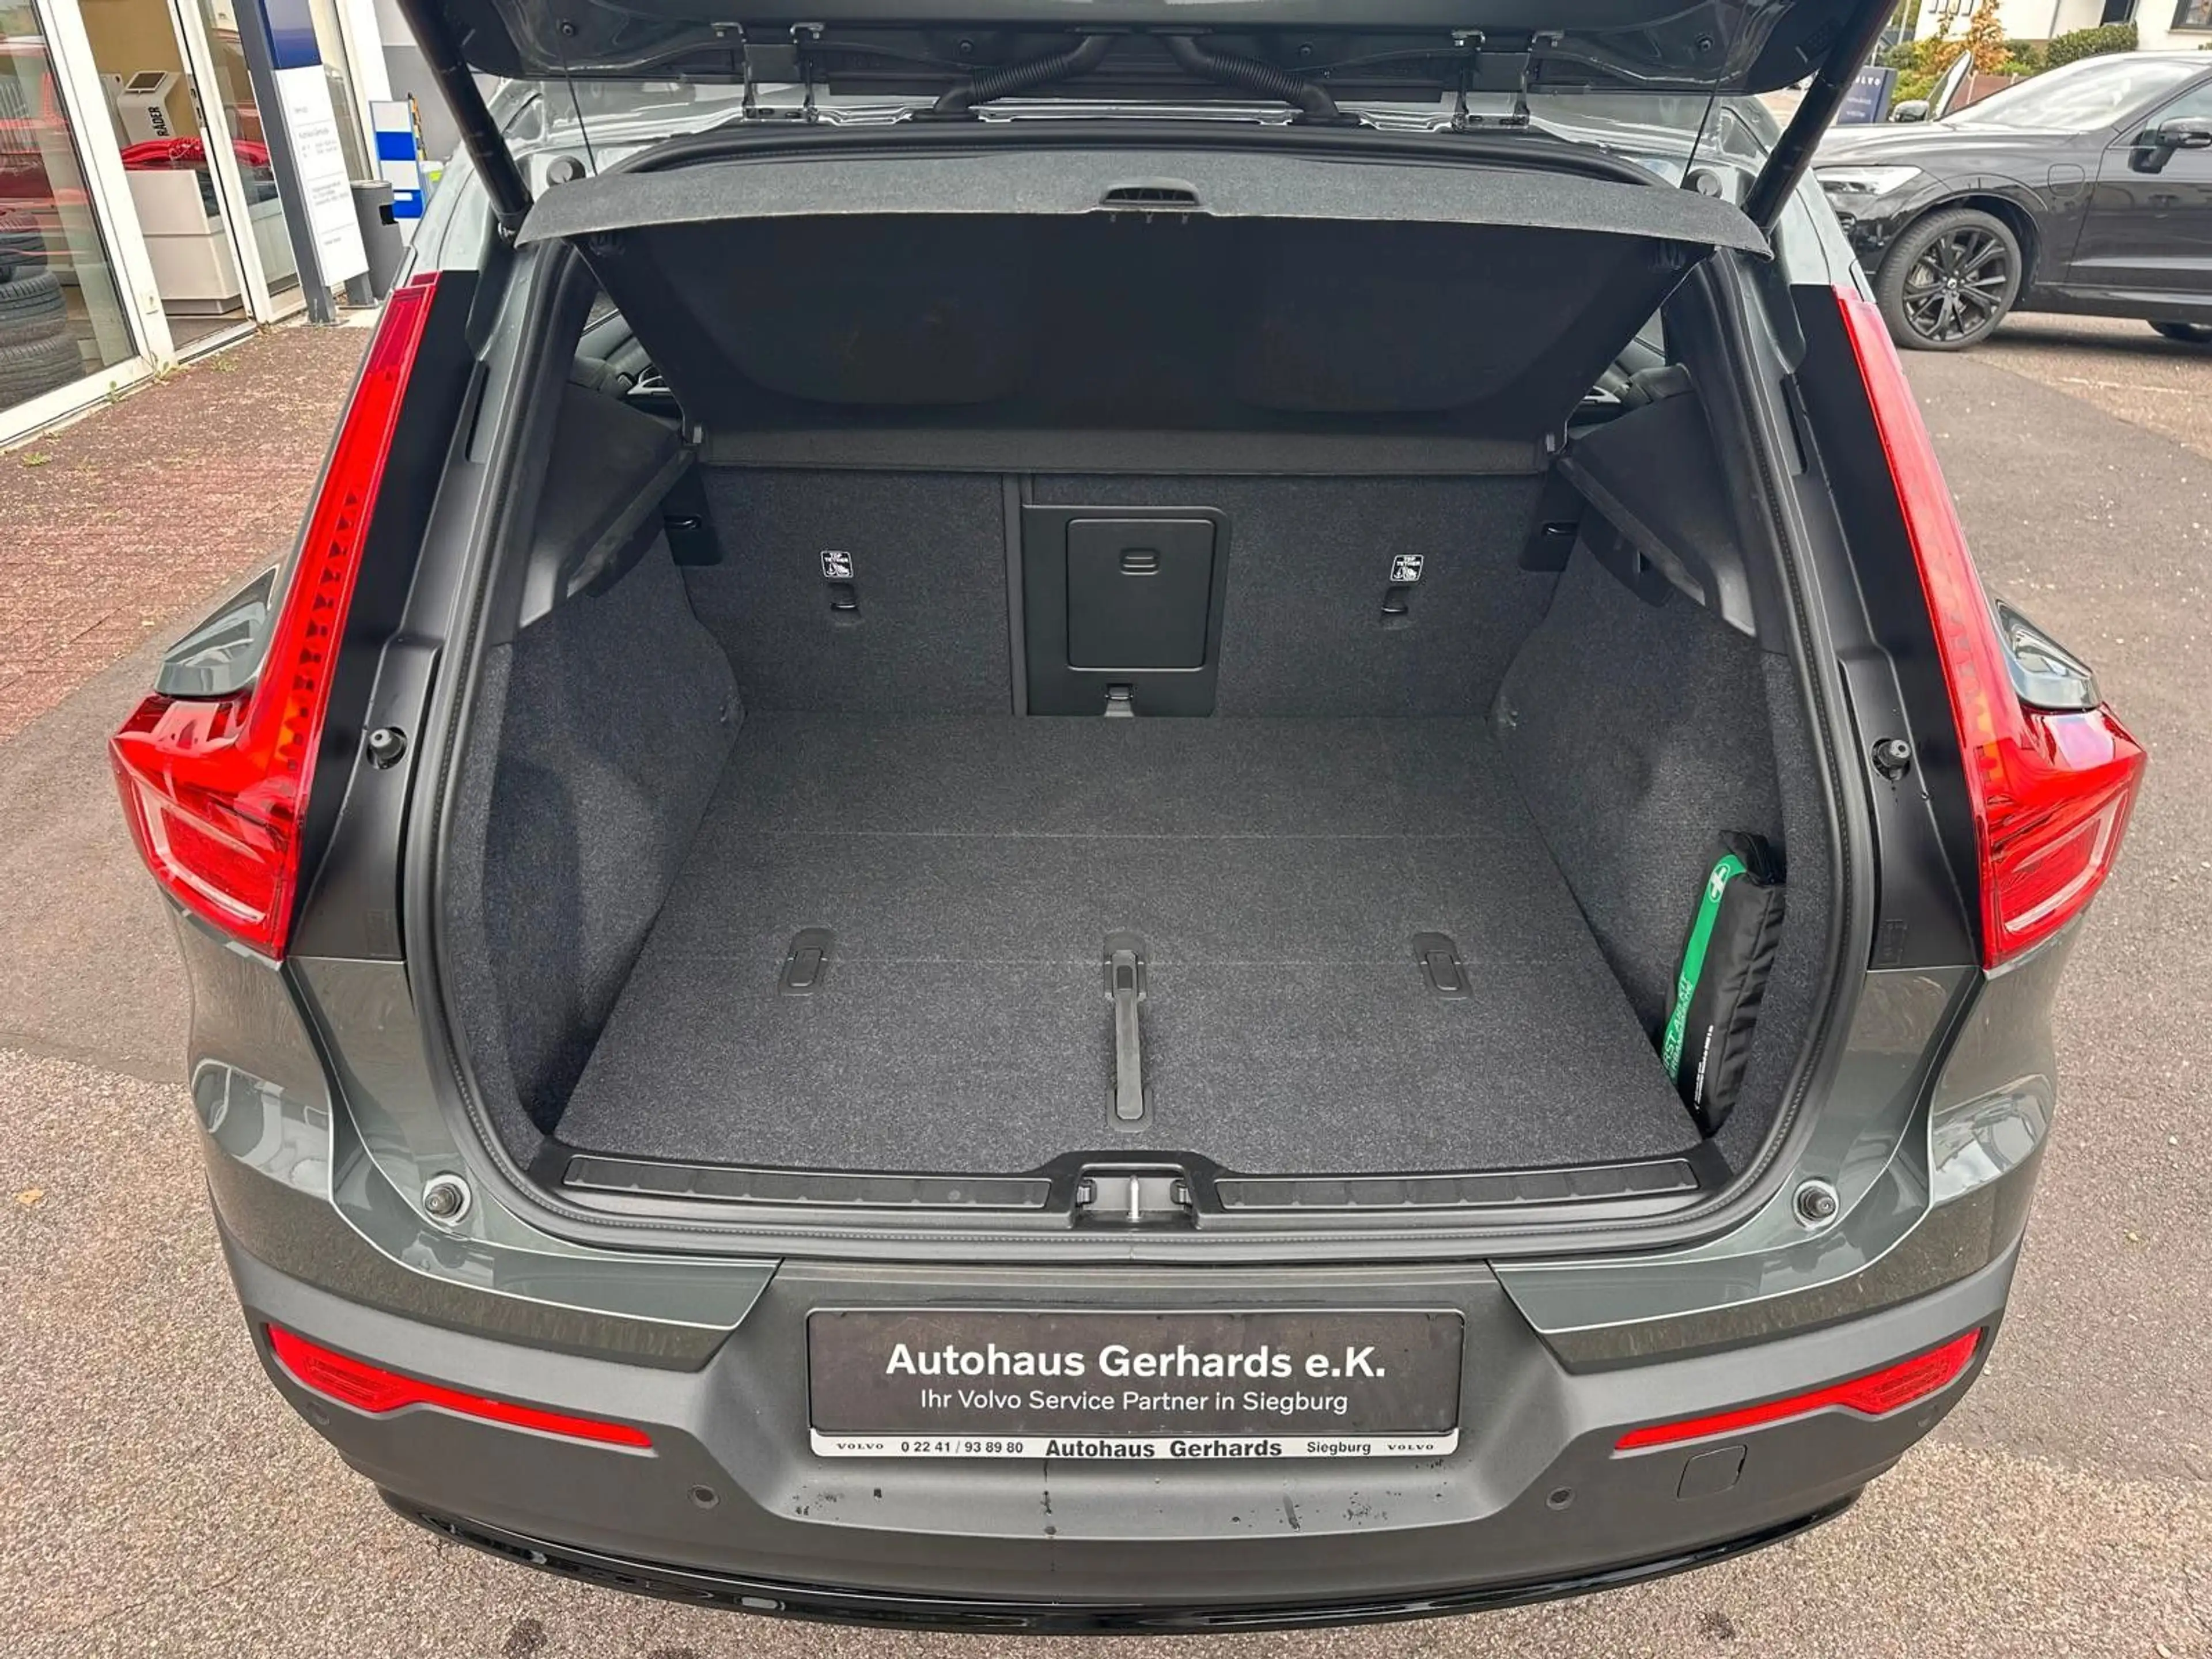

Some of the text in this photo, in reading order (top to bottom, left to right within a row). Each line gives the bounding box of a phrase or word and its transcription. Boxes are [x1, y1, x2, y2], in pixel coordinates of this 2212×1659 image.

[886, 1343, 1385, 1378] Autohaus Gerhards e.K.
[922, 1389, 1349, 1415] Ihr Volvo Service Partner in Siegburg
[901, 1441, 910, 1453] 0
[914, 1441, 931, 1453] 22
[934, 1441, 950, 1453] 41
[964, 1441, 982, 1453] 93
[985, 1441, 1002, 1454] 89
[1006, 1441, 1024, 1454] 80
[1045, 1439, 1154, 1457] Autohaus
[1169, 1439, 1282, 1457] Gerhards
[1306, 1441, 1372, 1455] Siegburg
